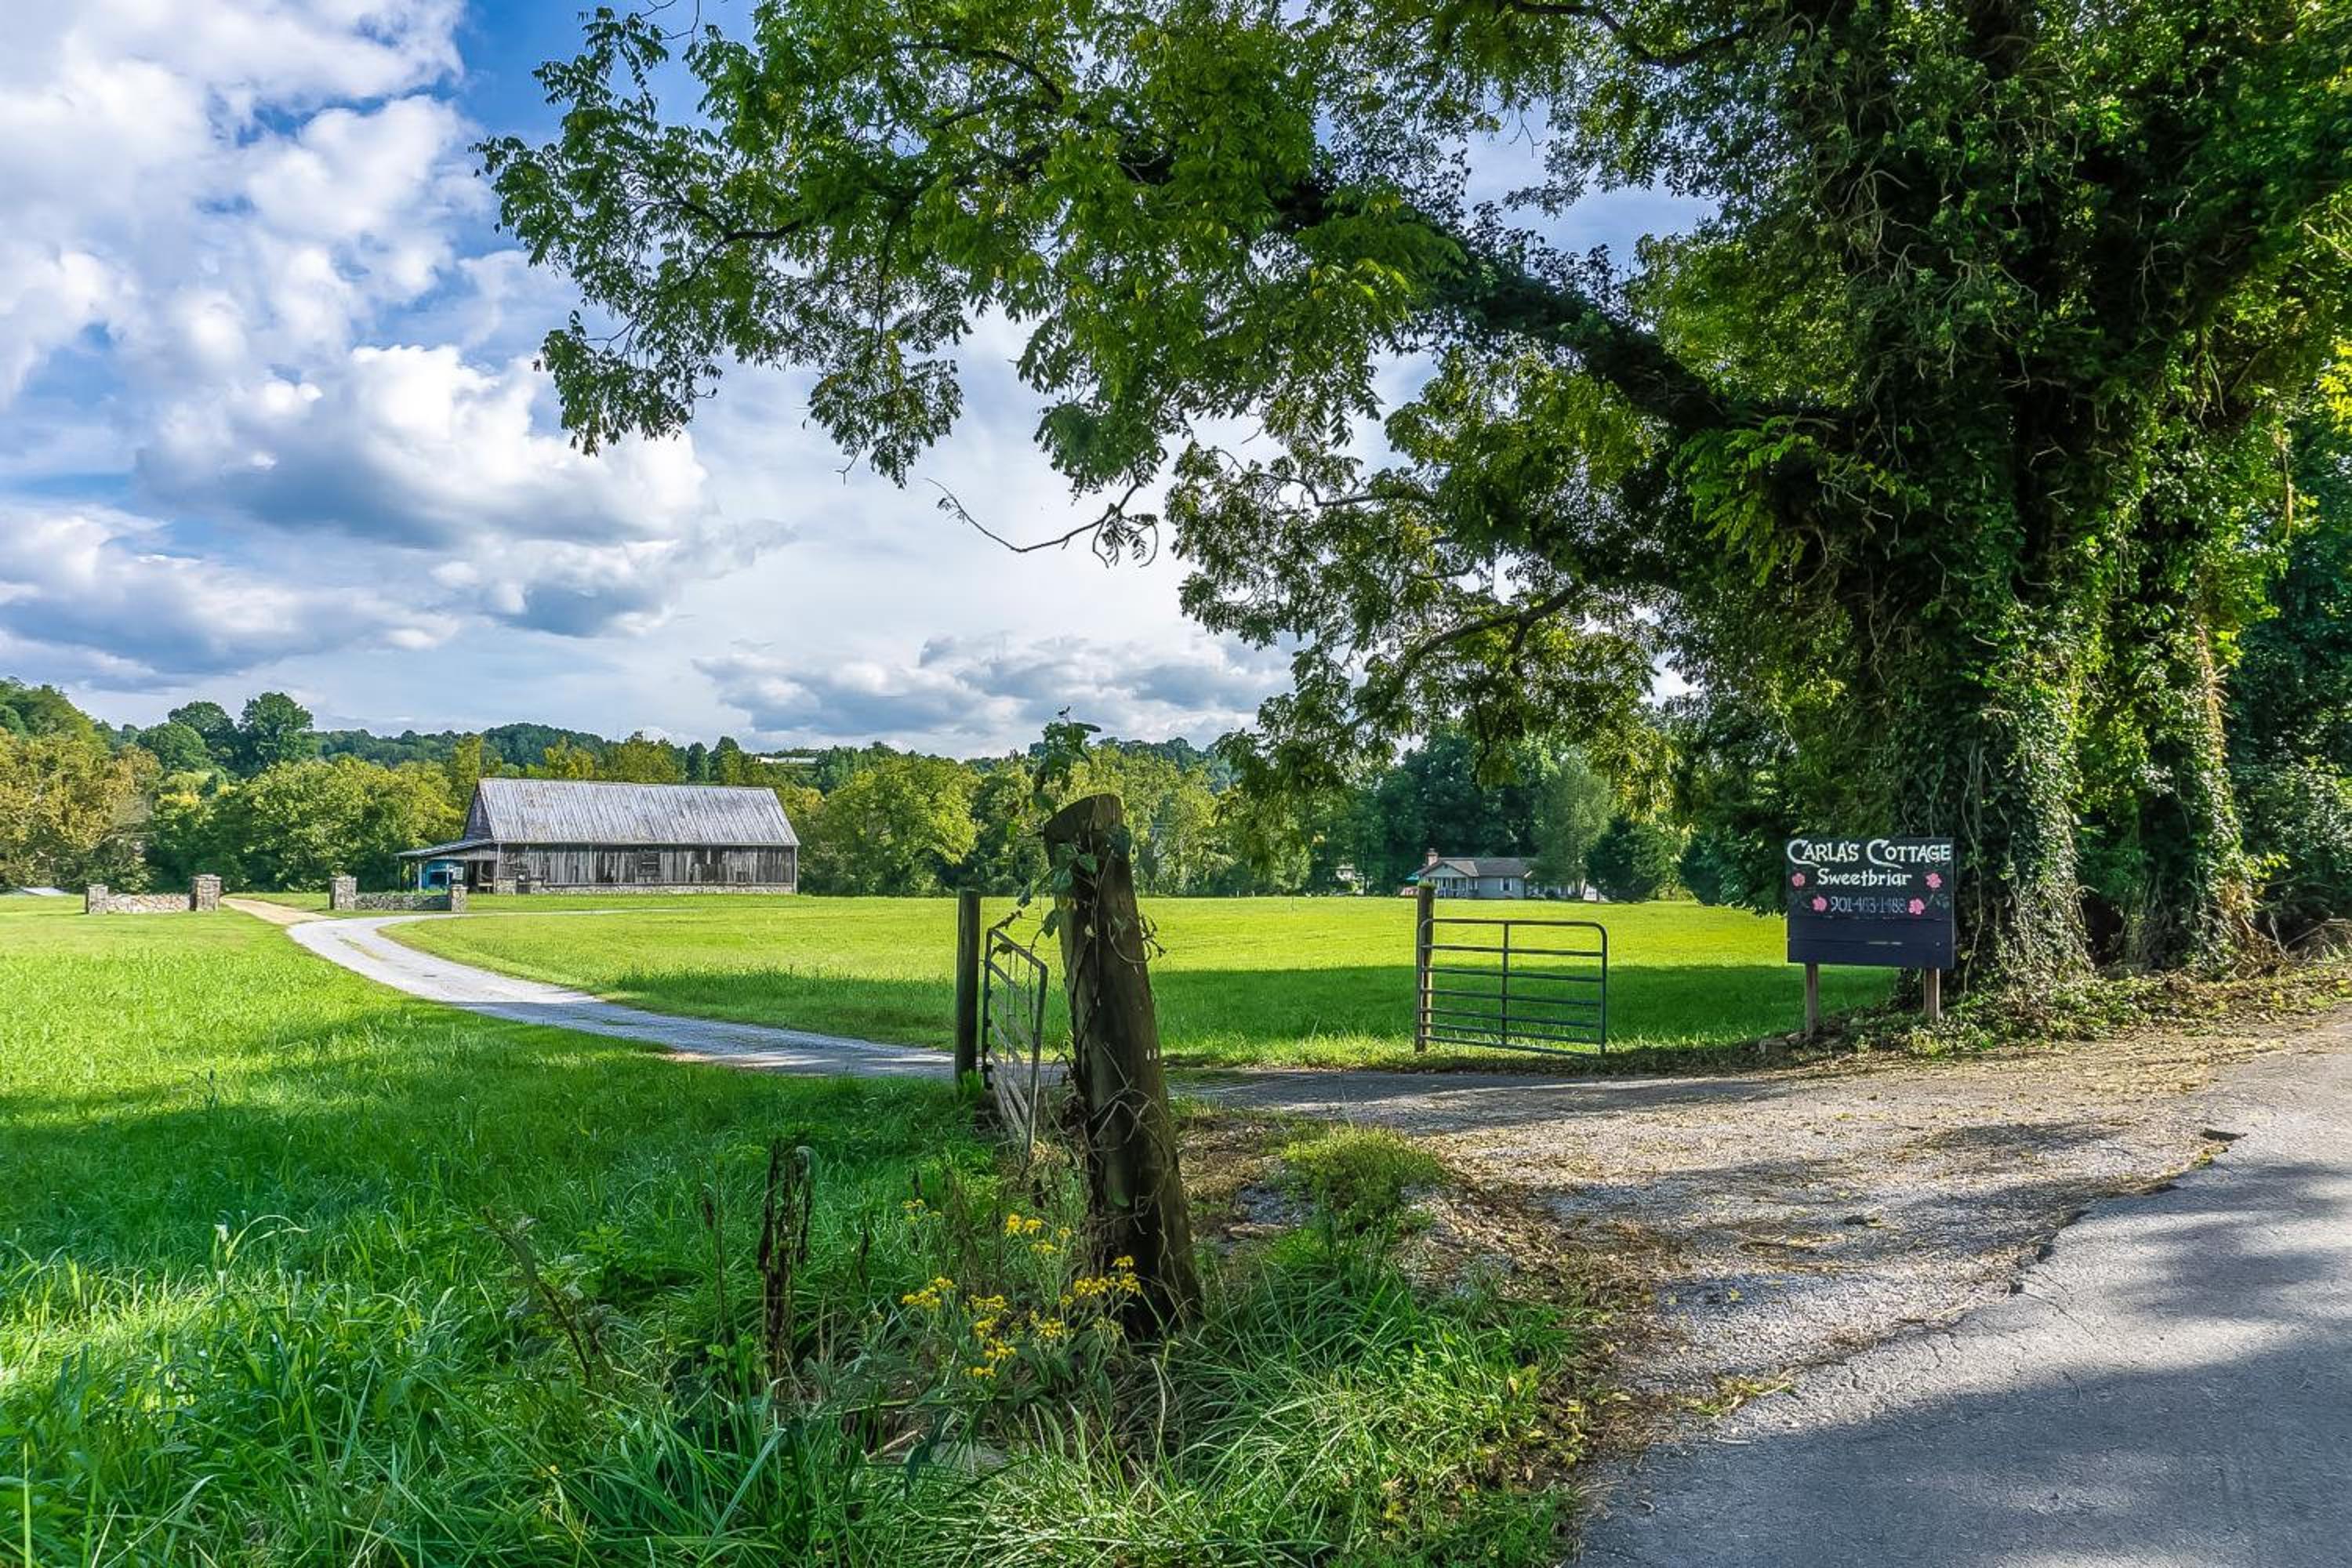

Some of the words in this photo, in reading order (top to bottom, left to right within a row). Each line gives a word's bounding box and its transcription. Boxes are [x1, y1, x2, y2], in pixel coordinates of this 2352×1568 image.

[1787, 838, 1860, 868] CARLA'S
[1866, 838, 1951, 868] COTTAGE
[1817, 868, 1912, 887] Sweetbriar
